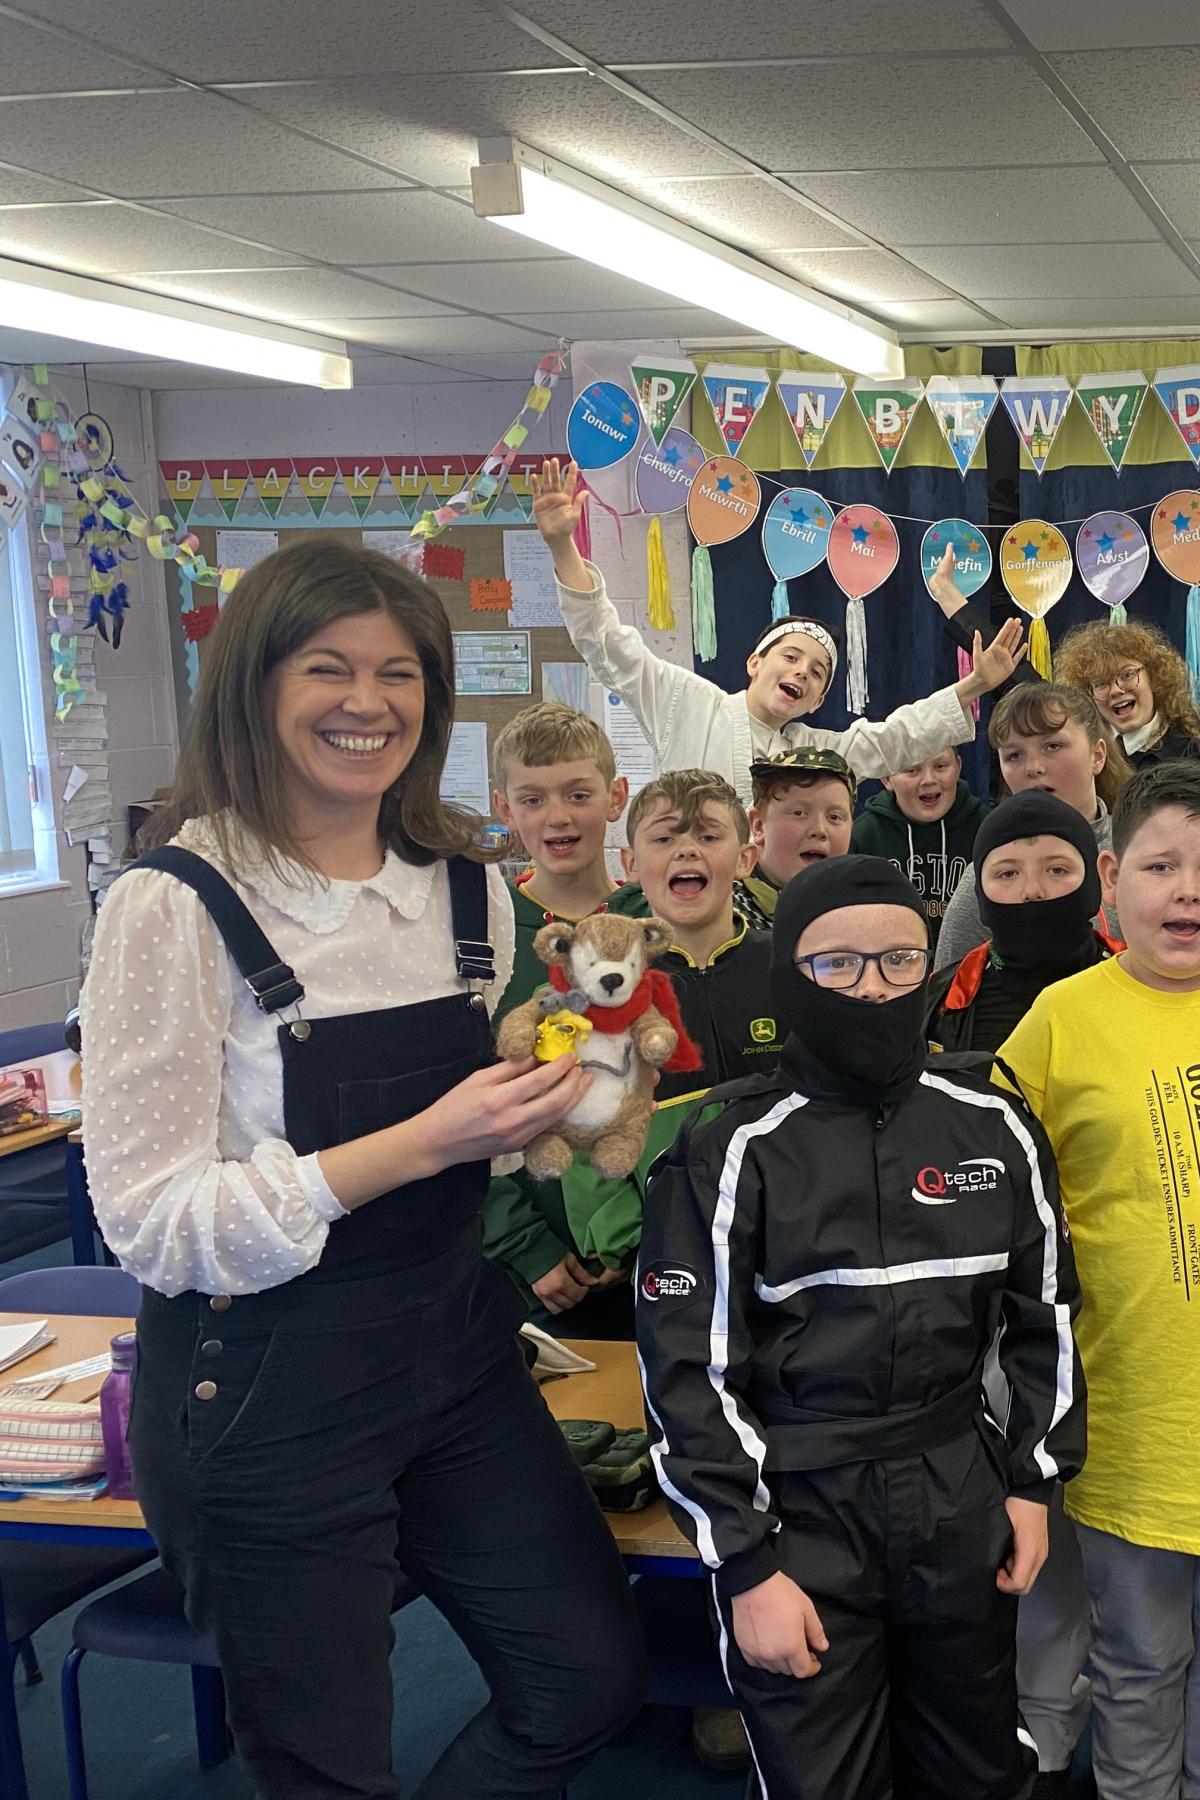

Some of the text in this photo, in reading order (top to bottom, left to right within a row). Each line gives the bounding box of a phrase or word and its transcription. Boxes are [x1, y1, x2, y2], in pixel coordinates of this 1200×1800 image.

[581, 407, 629, 443] Ionawr
[643, 453, 693, 487] Chwefro
[698, 484, 748, 517] Mawrth
[781, 520, 817, 545] Ebrill
[849, 541, 876, 559] Mai
[930, 555, 983, 574] Mefin
[1096, 549, 1129, 566] Awst
[1145, 1088, 1181, 1284] THIS GOLDEN TICKET ENSURES ADMITTANCE
[1178, 1161, 1190, 1198] (SHARP)
[1187, 1224, 1200, 1285] FRONT GATES
